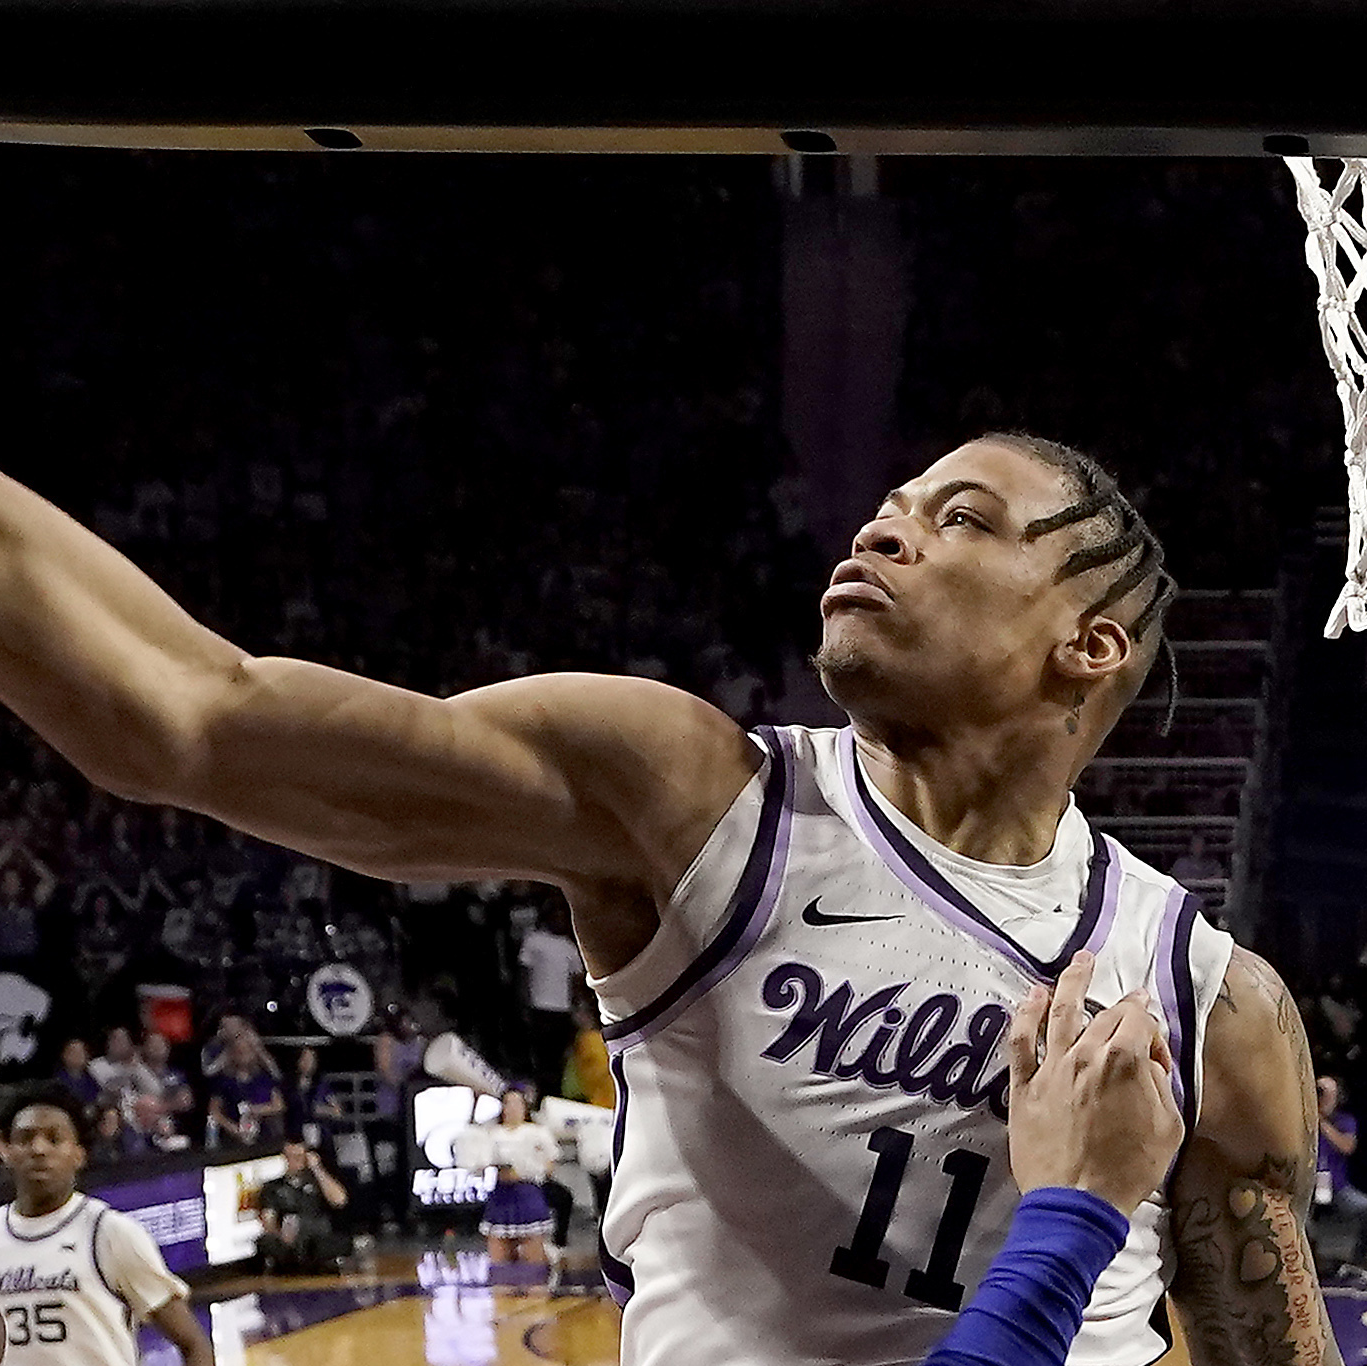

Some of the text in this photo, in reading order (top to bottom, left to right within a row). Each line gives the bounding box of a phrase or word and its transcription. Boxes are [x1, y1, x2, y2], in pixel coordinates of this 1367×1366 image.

[759, 961, 1011, 1125] Wild
[829, 1125, 990, 1313] 11
[6, 1302, 67, 1347] 35
